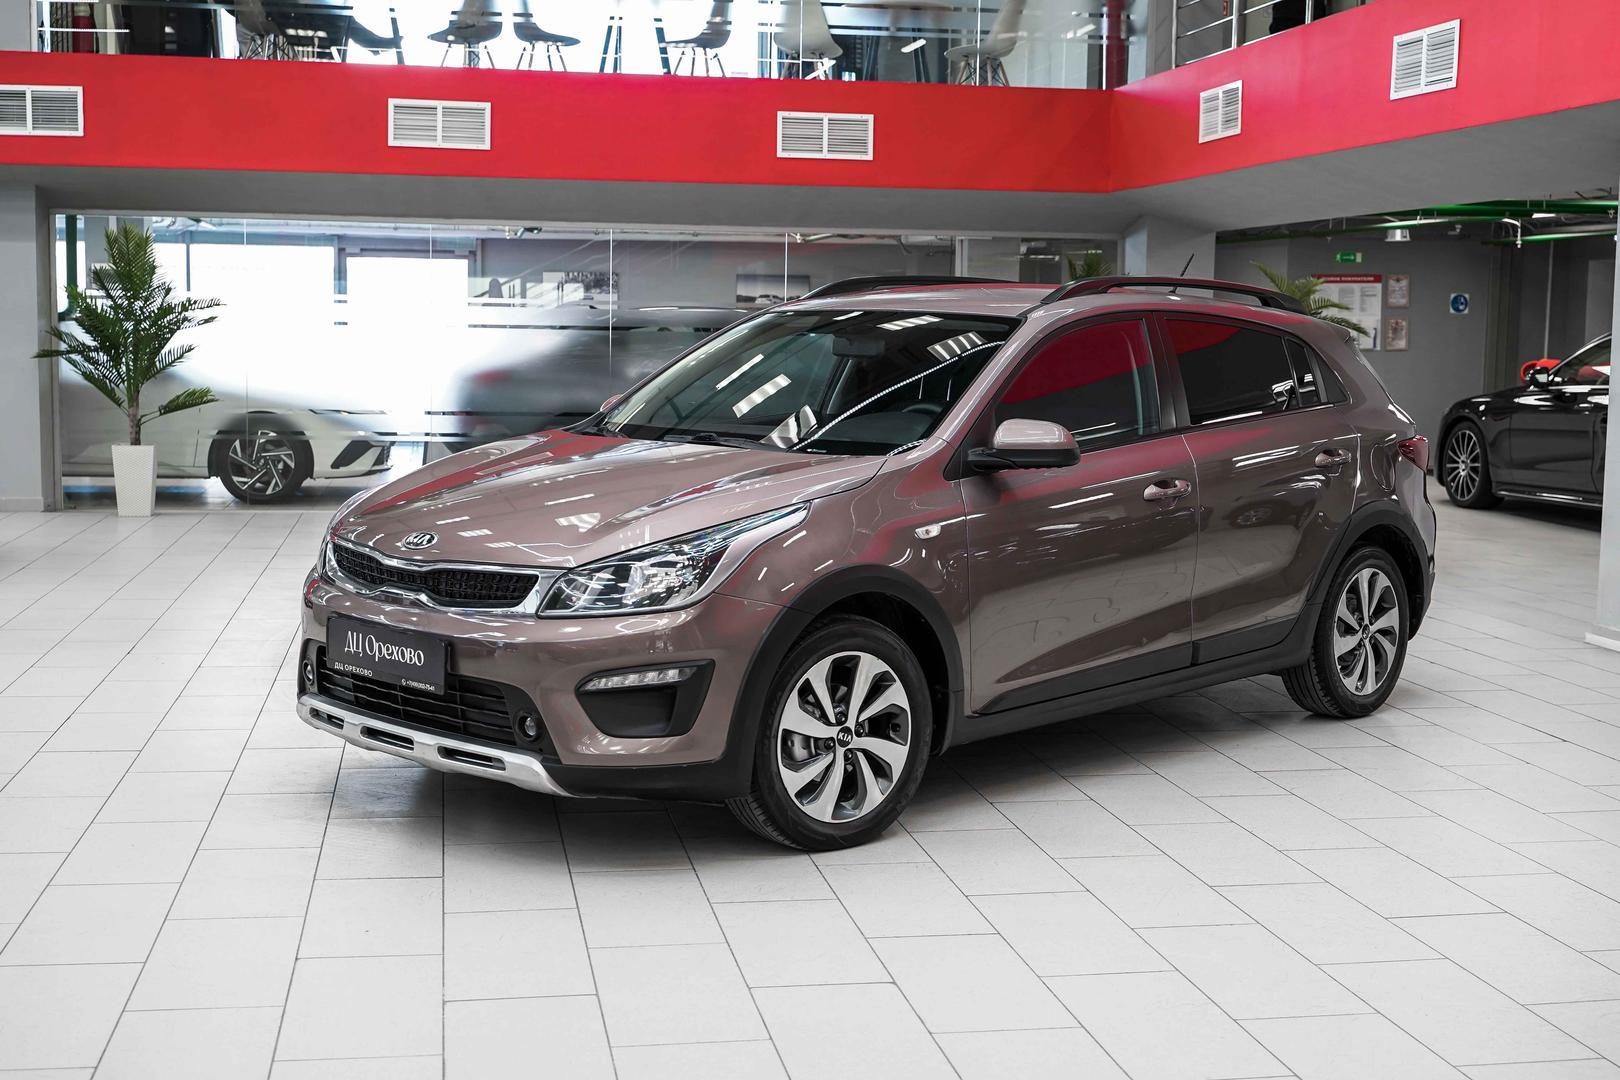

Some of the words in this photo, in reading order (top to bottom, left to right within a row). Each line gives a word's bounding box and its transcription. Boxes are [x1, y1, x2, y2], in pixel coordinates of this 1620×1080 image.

[344, 630, 363, 657] ДЦ
[365, 634, 424, 666] Орехово
[334, 661, 344, 670] ДЦ
[344, 664, 373, 677] ОРЕХОВО
[837, 731, 852, 743] KIA
